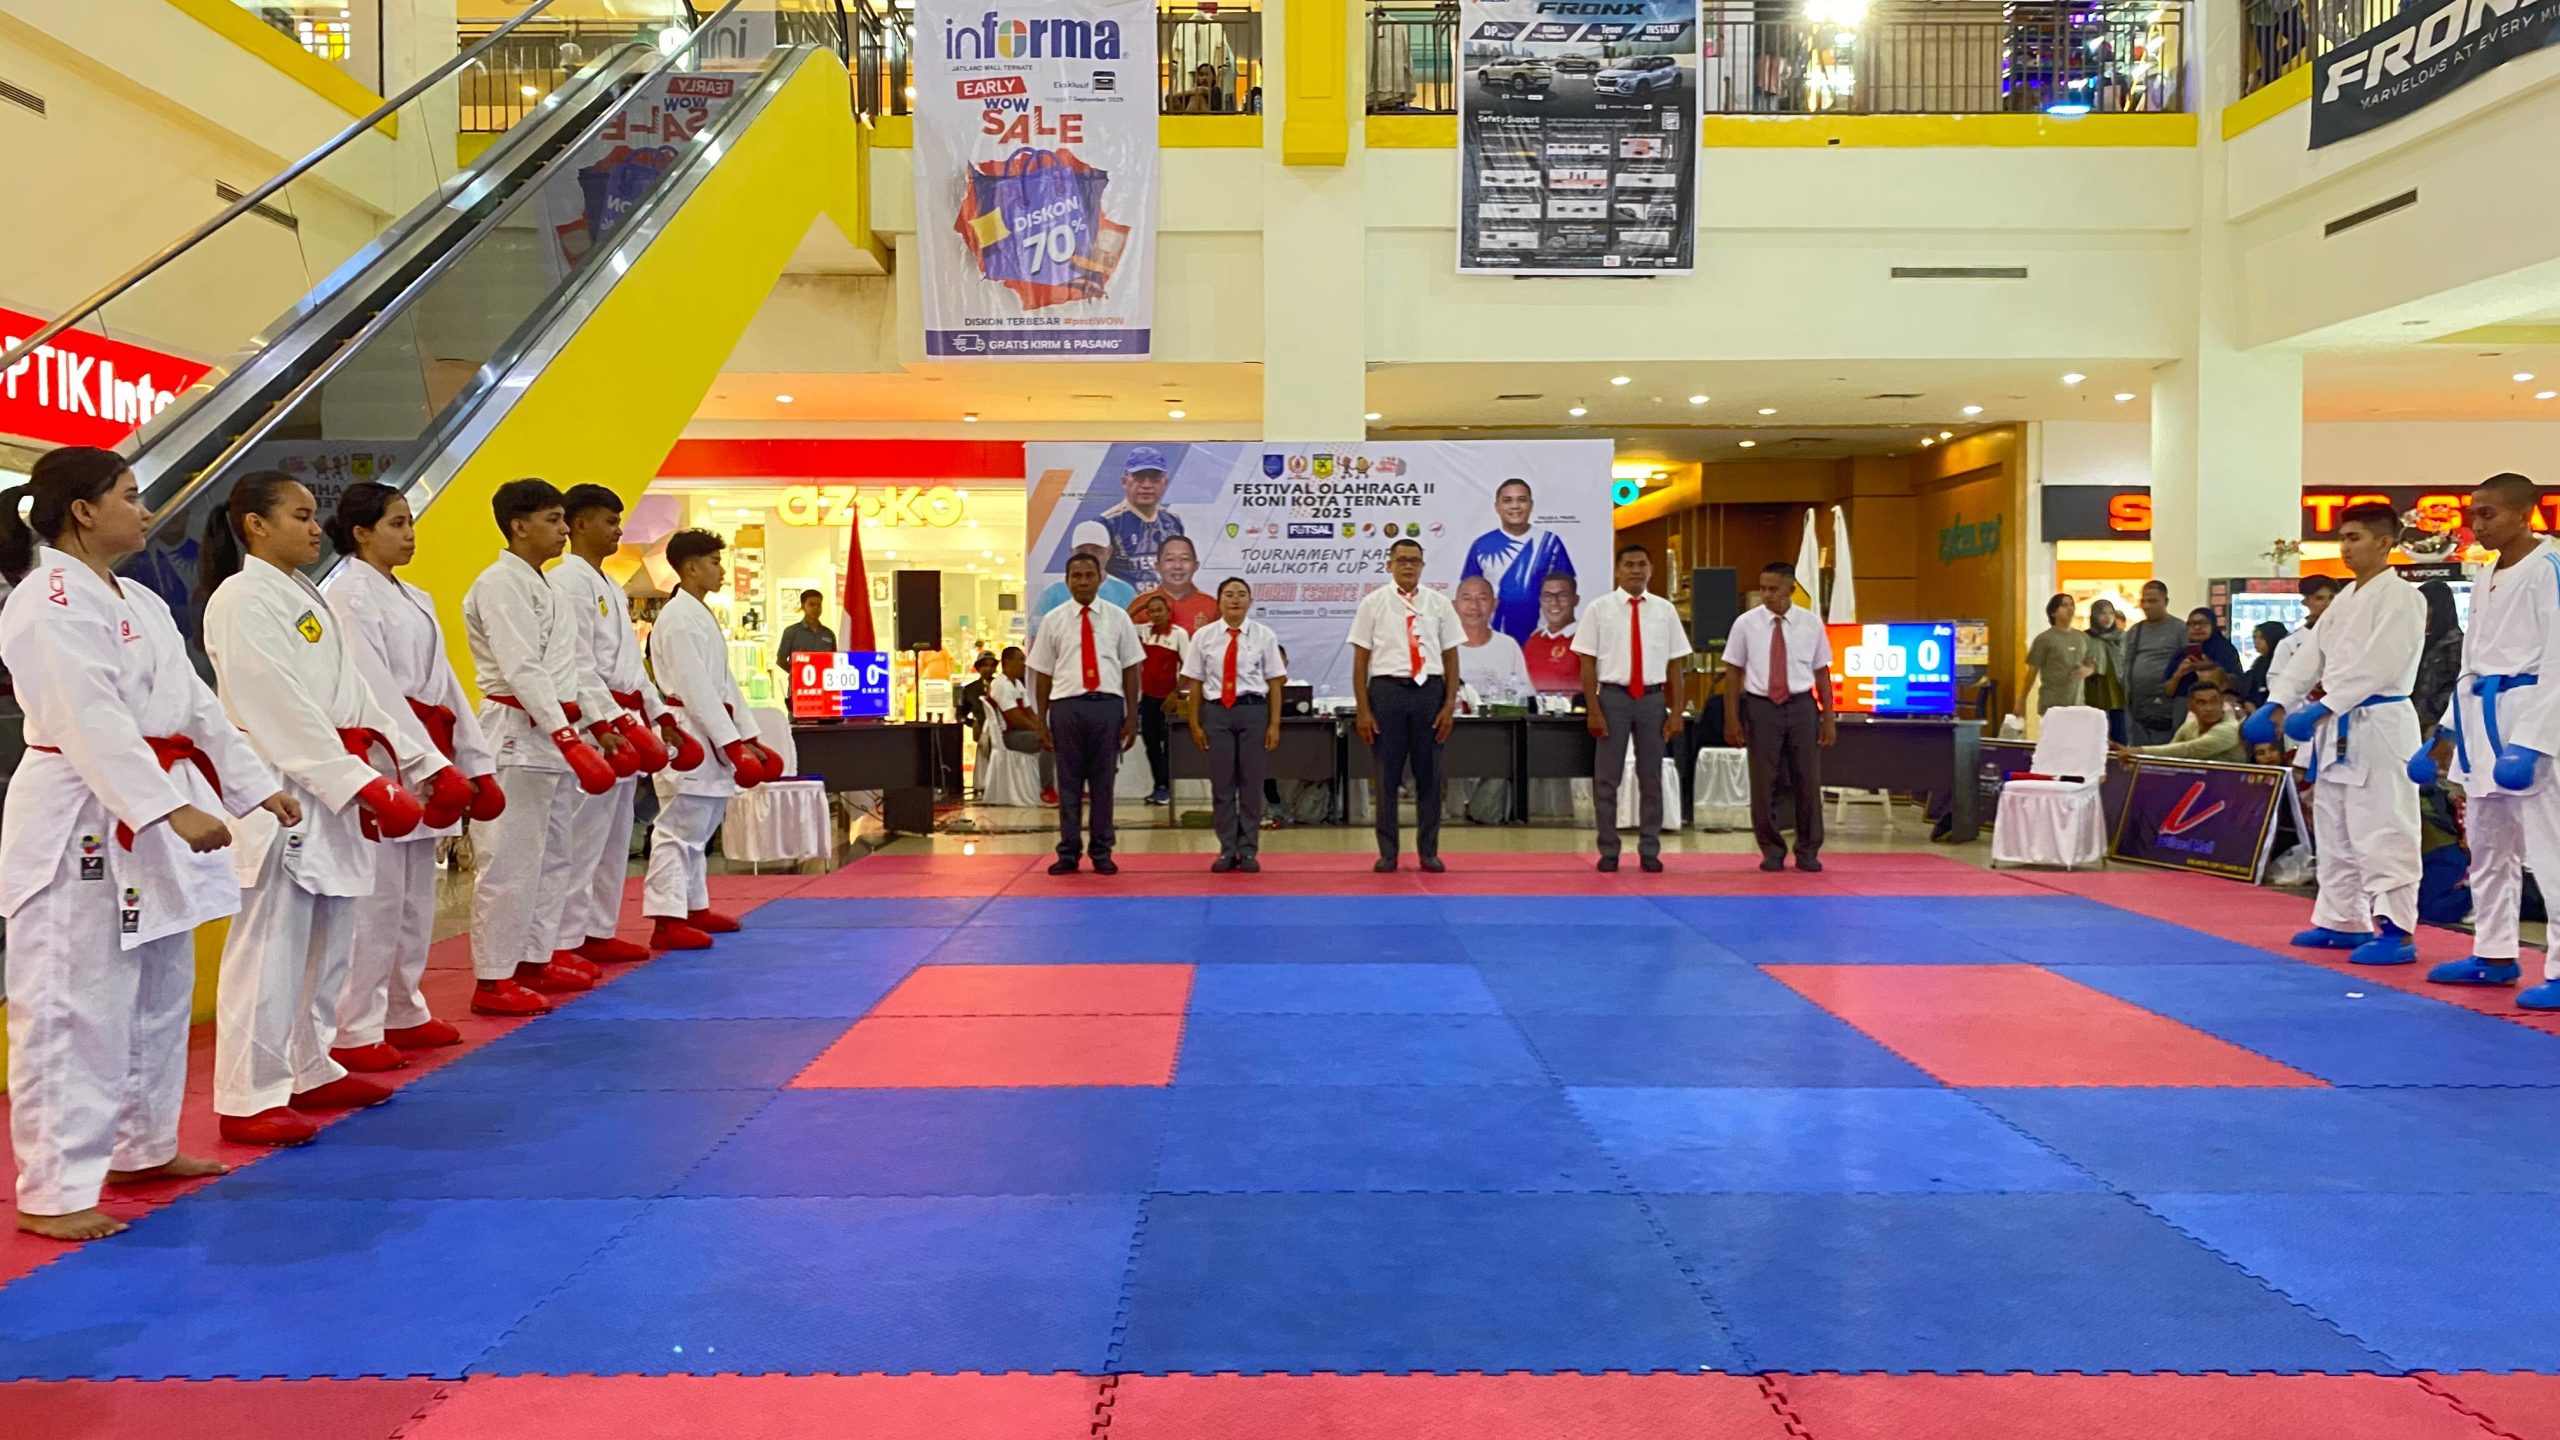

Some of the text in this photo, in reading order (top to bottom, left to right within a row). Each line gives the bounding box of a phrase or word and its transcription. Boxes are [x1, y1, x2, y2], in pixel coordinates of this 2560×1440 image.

[1536, 2, 1645, 15] FRONX
[946, 11, 1120, 59] informa
[1646, 24, 1680, 34] INSTANT
[2453, 44, 2474, 66] AT
[2478, 14, 2535, 51] EVERY
[963, 79, 1016, 97] EARLY
[984, 98, 1030, 113] WOW
[982, 105, 1084, 144] SALE
[1478, 115, 1505, 125] Safety
[1507, 115, 1541, 125] Support
[1013, 196, 1079, 233] DISKON
[964, 317, 1003, 326] DISKON
[1006, 317, 1060, 326] TERBESAR
[989, 341, 1029, 350] GRATIS
[1030, 341, 1061, 350] KIRIM
[1063, 341, 1072, 349] &
[0, 335, 96, 417] PTIK
[1233, 483, 1434, 495] FESTIVAL OLAHRAGA II
[1243, 495, 1421, 507] KONI KOTA TERNATE
[1312, 508, 1351, 518] 2025
[1289, 525, 1332, 535] FUTSAL
[1241, 548, 1355, 561] TOURNAMENT
[1245, 563, 1328, 574] WALIKOTA
[1337, 563, 1368, 574] CUP
[1917, 639, 1941, 671] 0
[802, 664, 816, 686] 0
[826, 673, 857, 687] 3:00
[866, 664, 880, 686] 0
